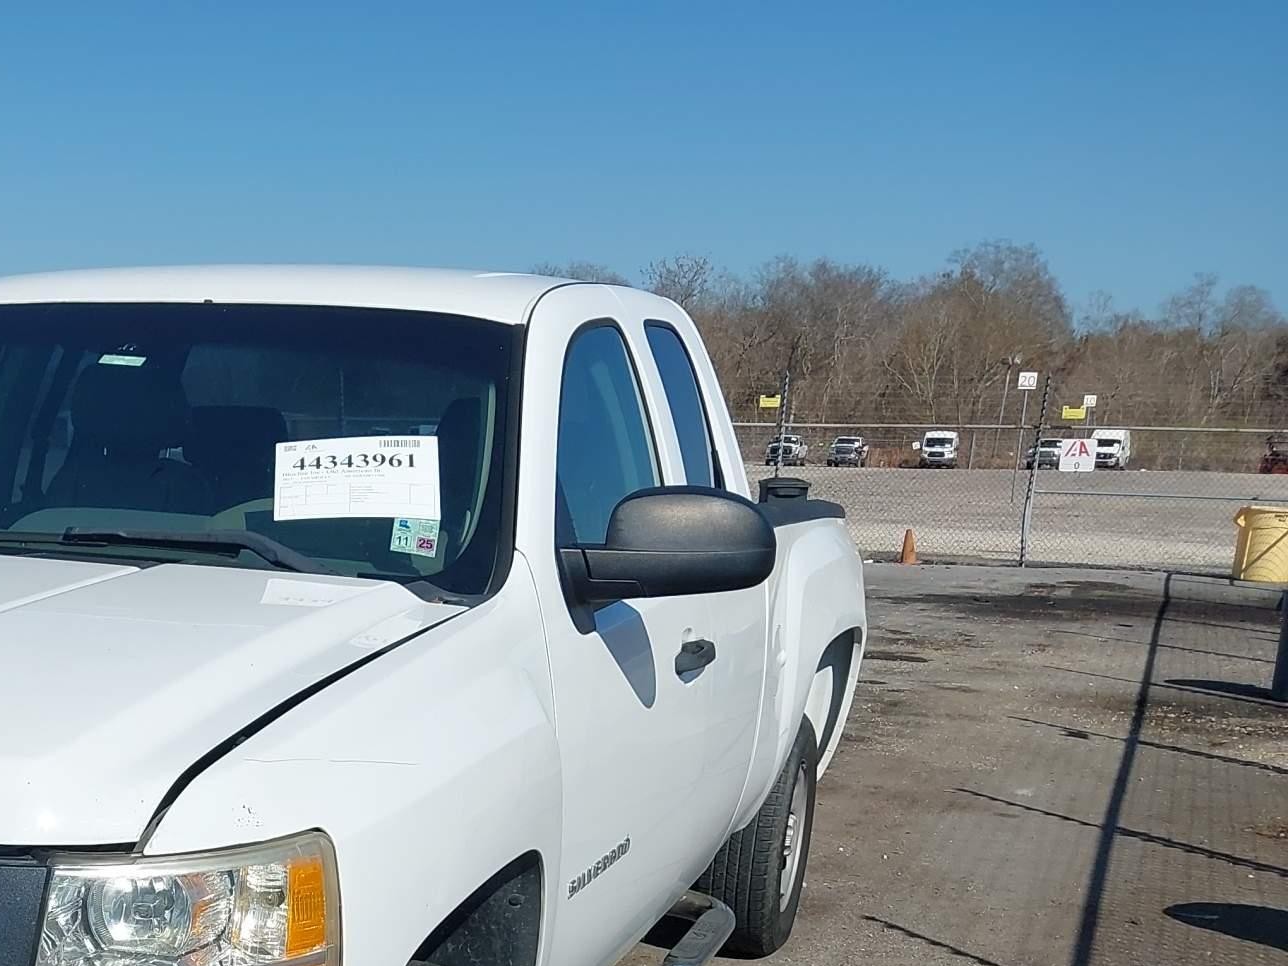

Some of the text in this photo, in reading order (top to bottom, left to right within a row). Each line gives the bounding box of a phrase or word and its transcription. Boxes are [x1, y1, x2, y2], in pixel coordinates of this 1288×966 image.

[1020, 375, 1036, 387] 20
[292, 453, 417, 471] 44343961
[396, 535, 409, 547] 11
[418, 538, 433, 550] 25
